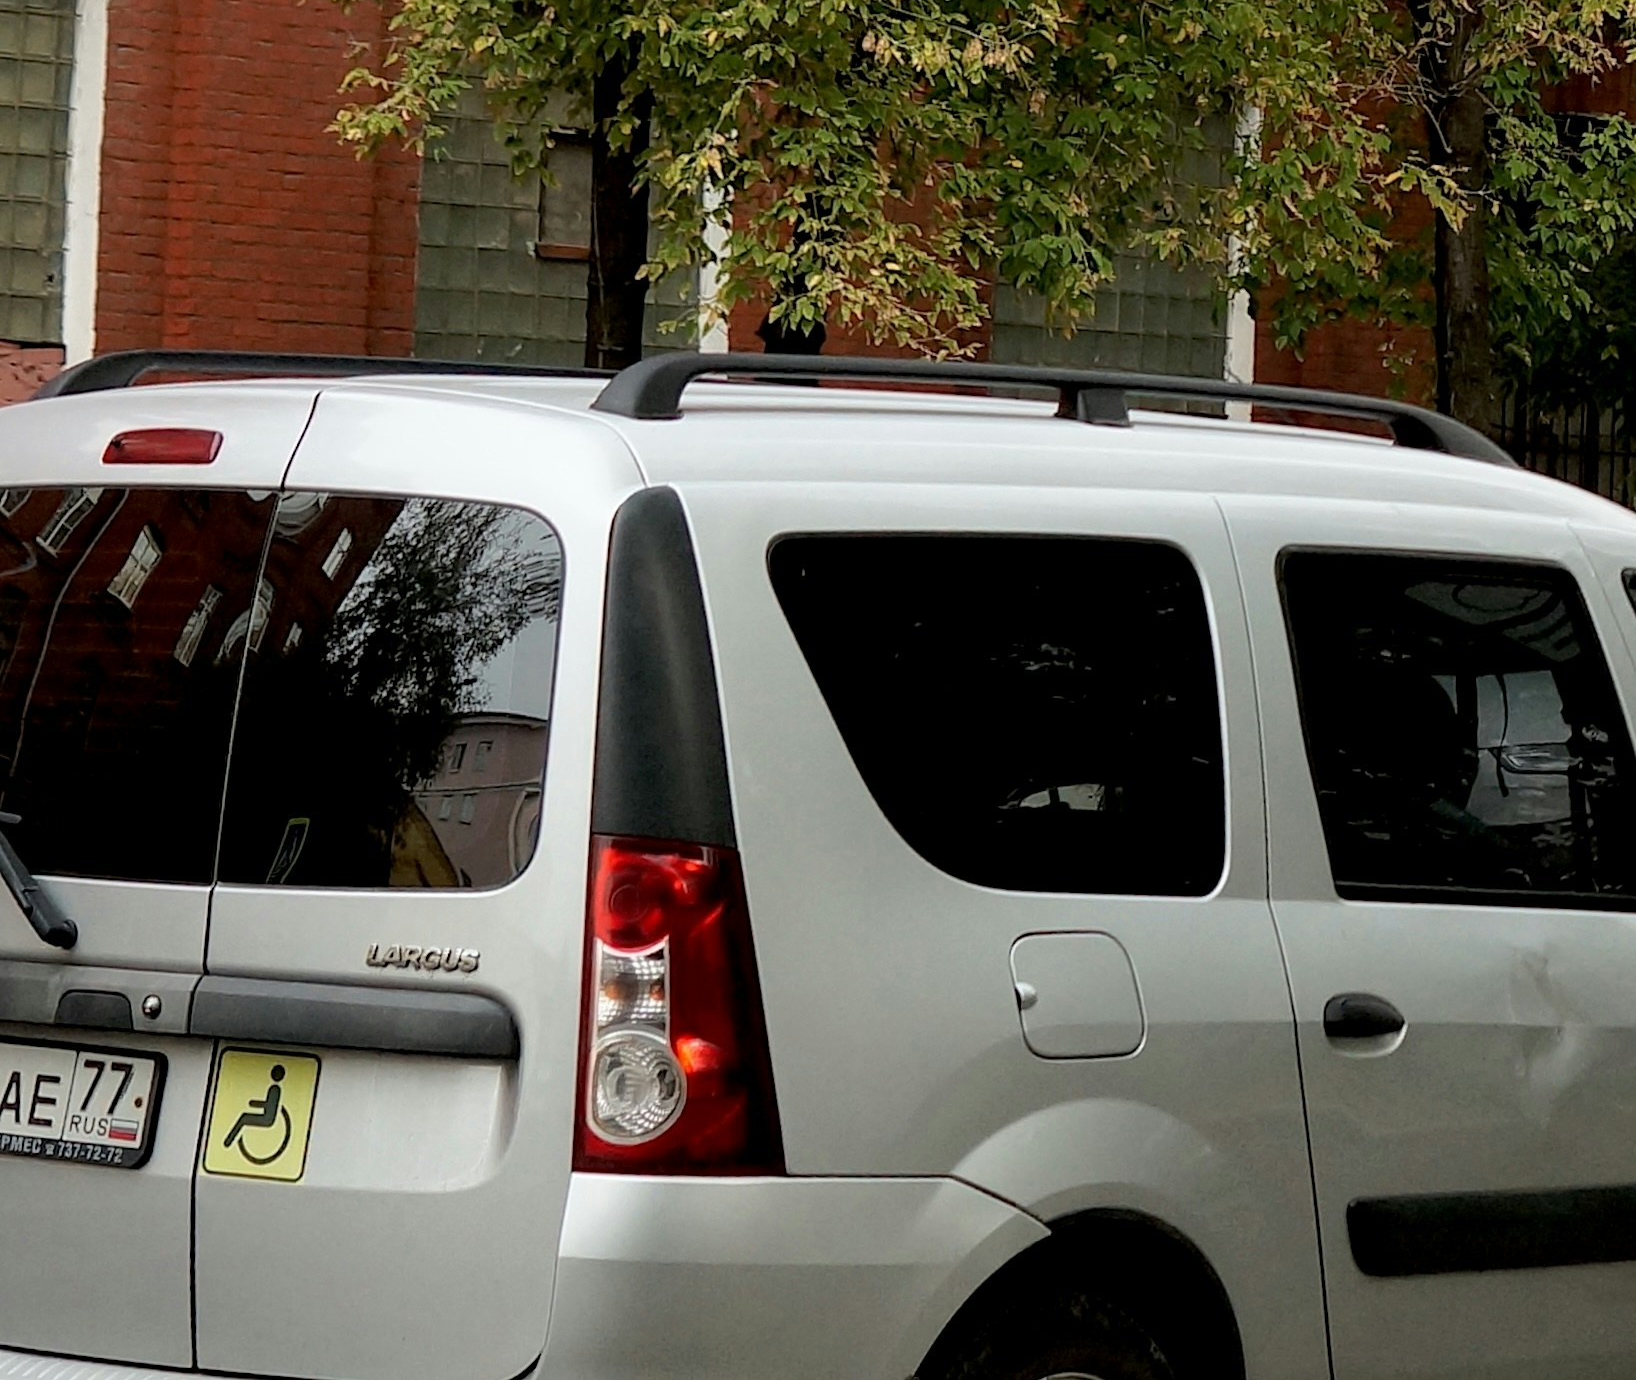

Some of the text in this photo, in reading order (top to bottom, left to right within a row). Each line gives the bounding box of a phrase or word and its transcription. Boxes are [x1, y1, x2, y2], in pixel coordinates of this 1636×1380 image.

[366, 942, 480, 973] LARGUS
[80, 1058, 133, 1115] 77
[69, 1114, 108, 1137] RUS
[58, 1141, 123, 1164] 737-72-72
